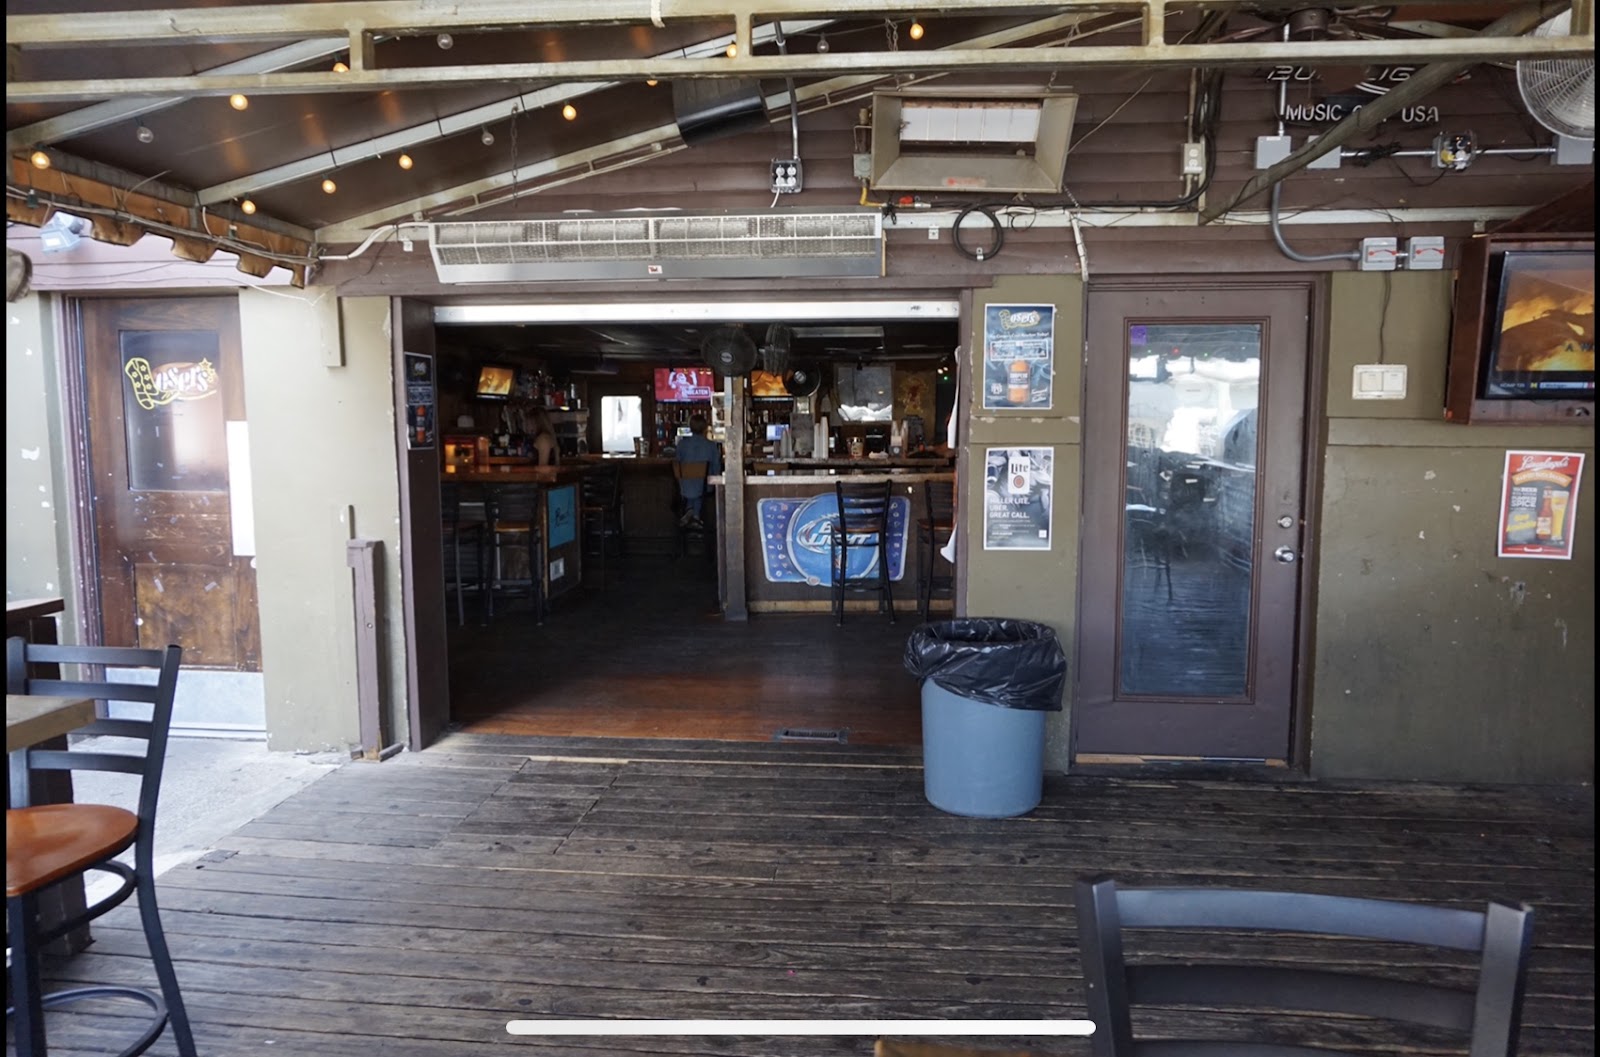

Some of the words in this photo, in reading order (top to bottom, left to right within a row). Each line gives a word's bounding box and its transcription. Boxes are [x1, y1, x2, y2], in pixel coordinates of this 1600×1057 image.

[1285, 104, 1342, 121] MUSIC
[1401, 105, 1439, 123] USA
[1011, 463, 1029, 475] Lite
[989, 511, 1011, 519] GREAT
